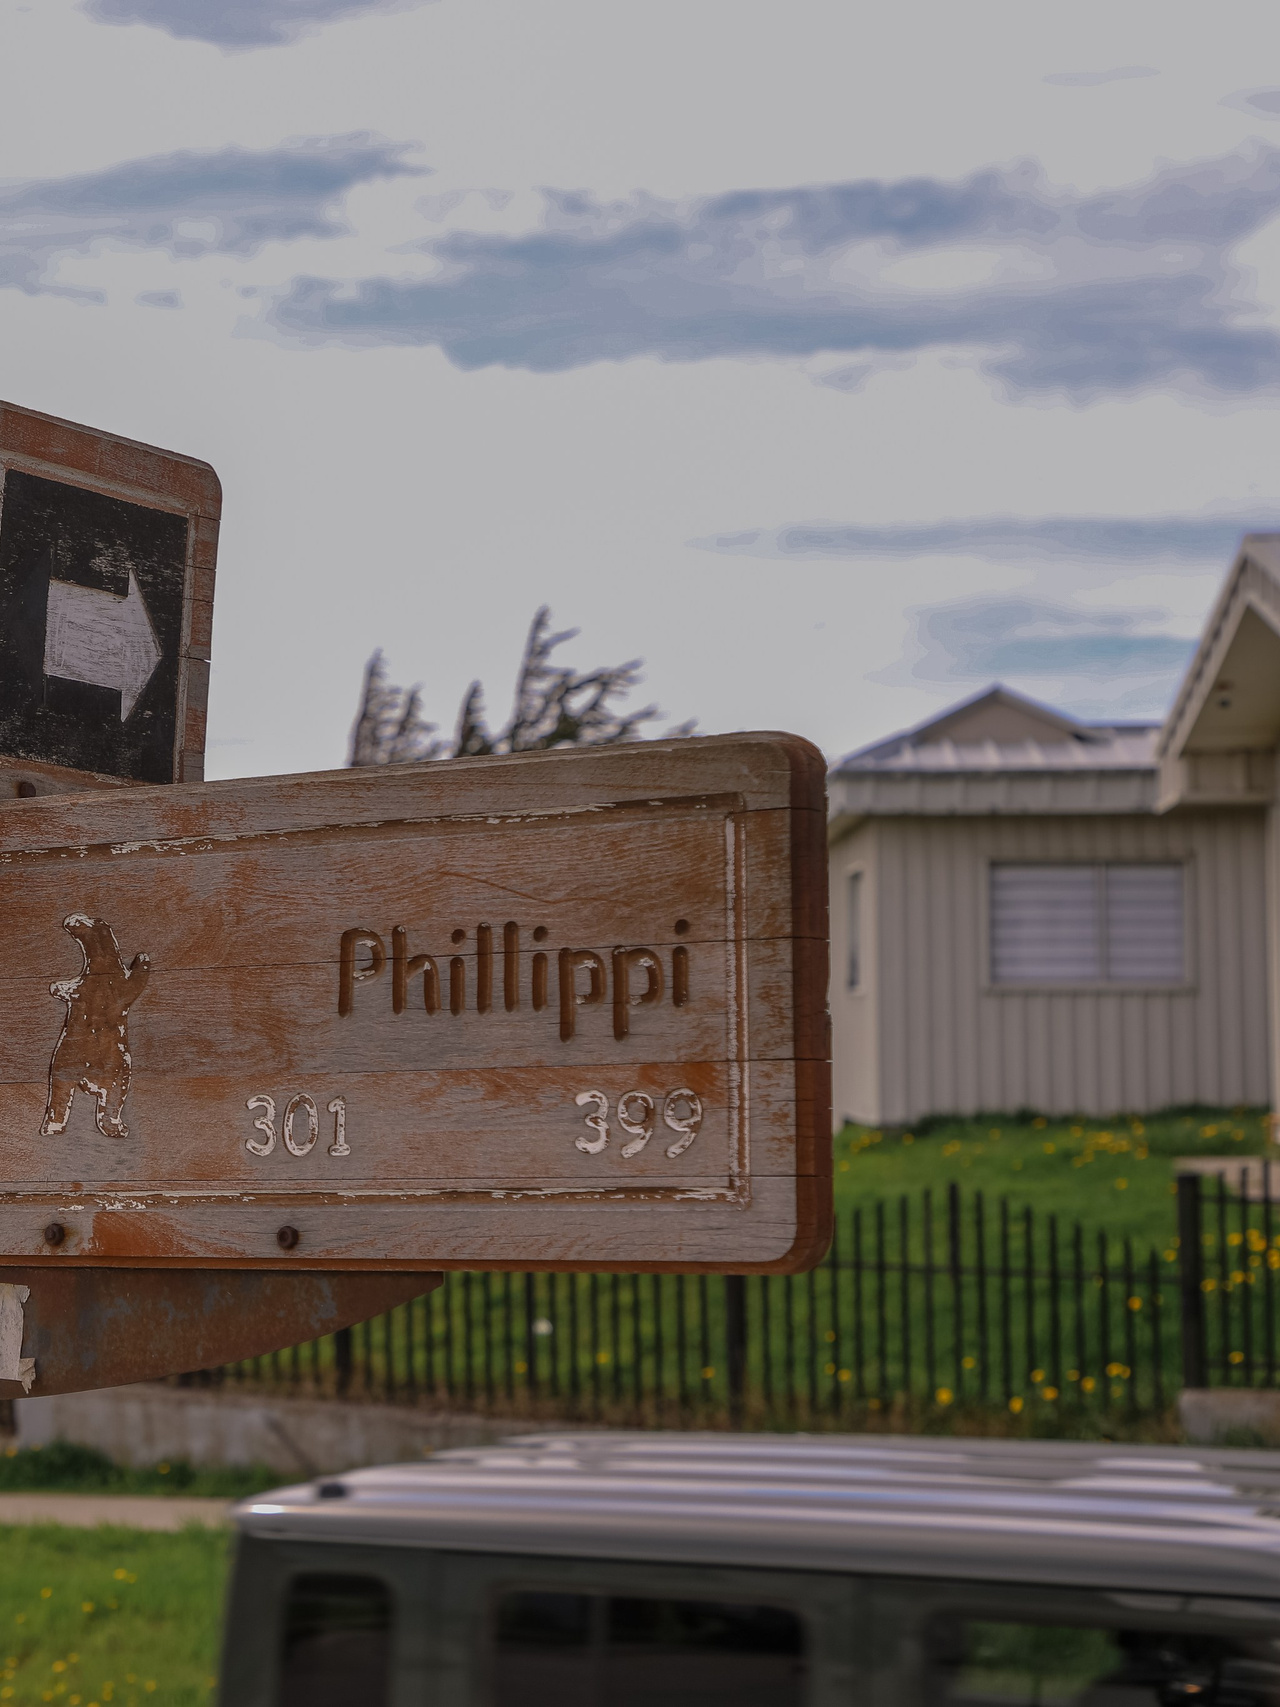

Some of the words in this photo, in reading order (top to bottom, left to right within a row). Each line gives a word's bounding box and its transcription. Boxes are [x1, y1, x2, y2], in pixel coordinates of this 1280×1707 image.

[337, 918, 690, 1043] Phillippi
[244, 1092, 351, 1158] 301
[574, 1087, 703, 1159] 399
